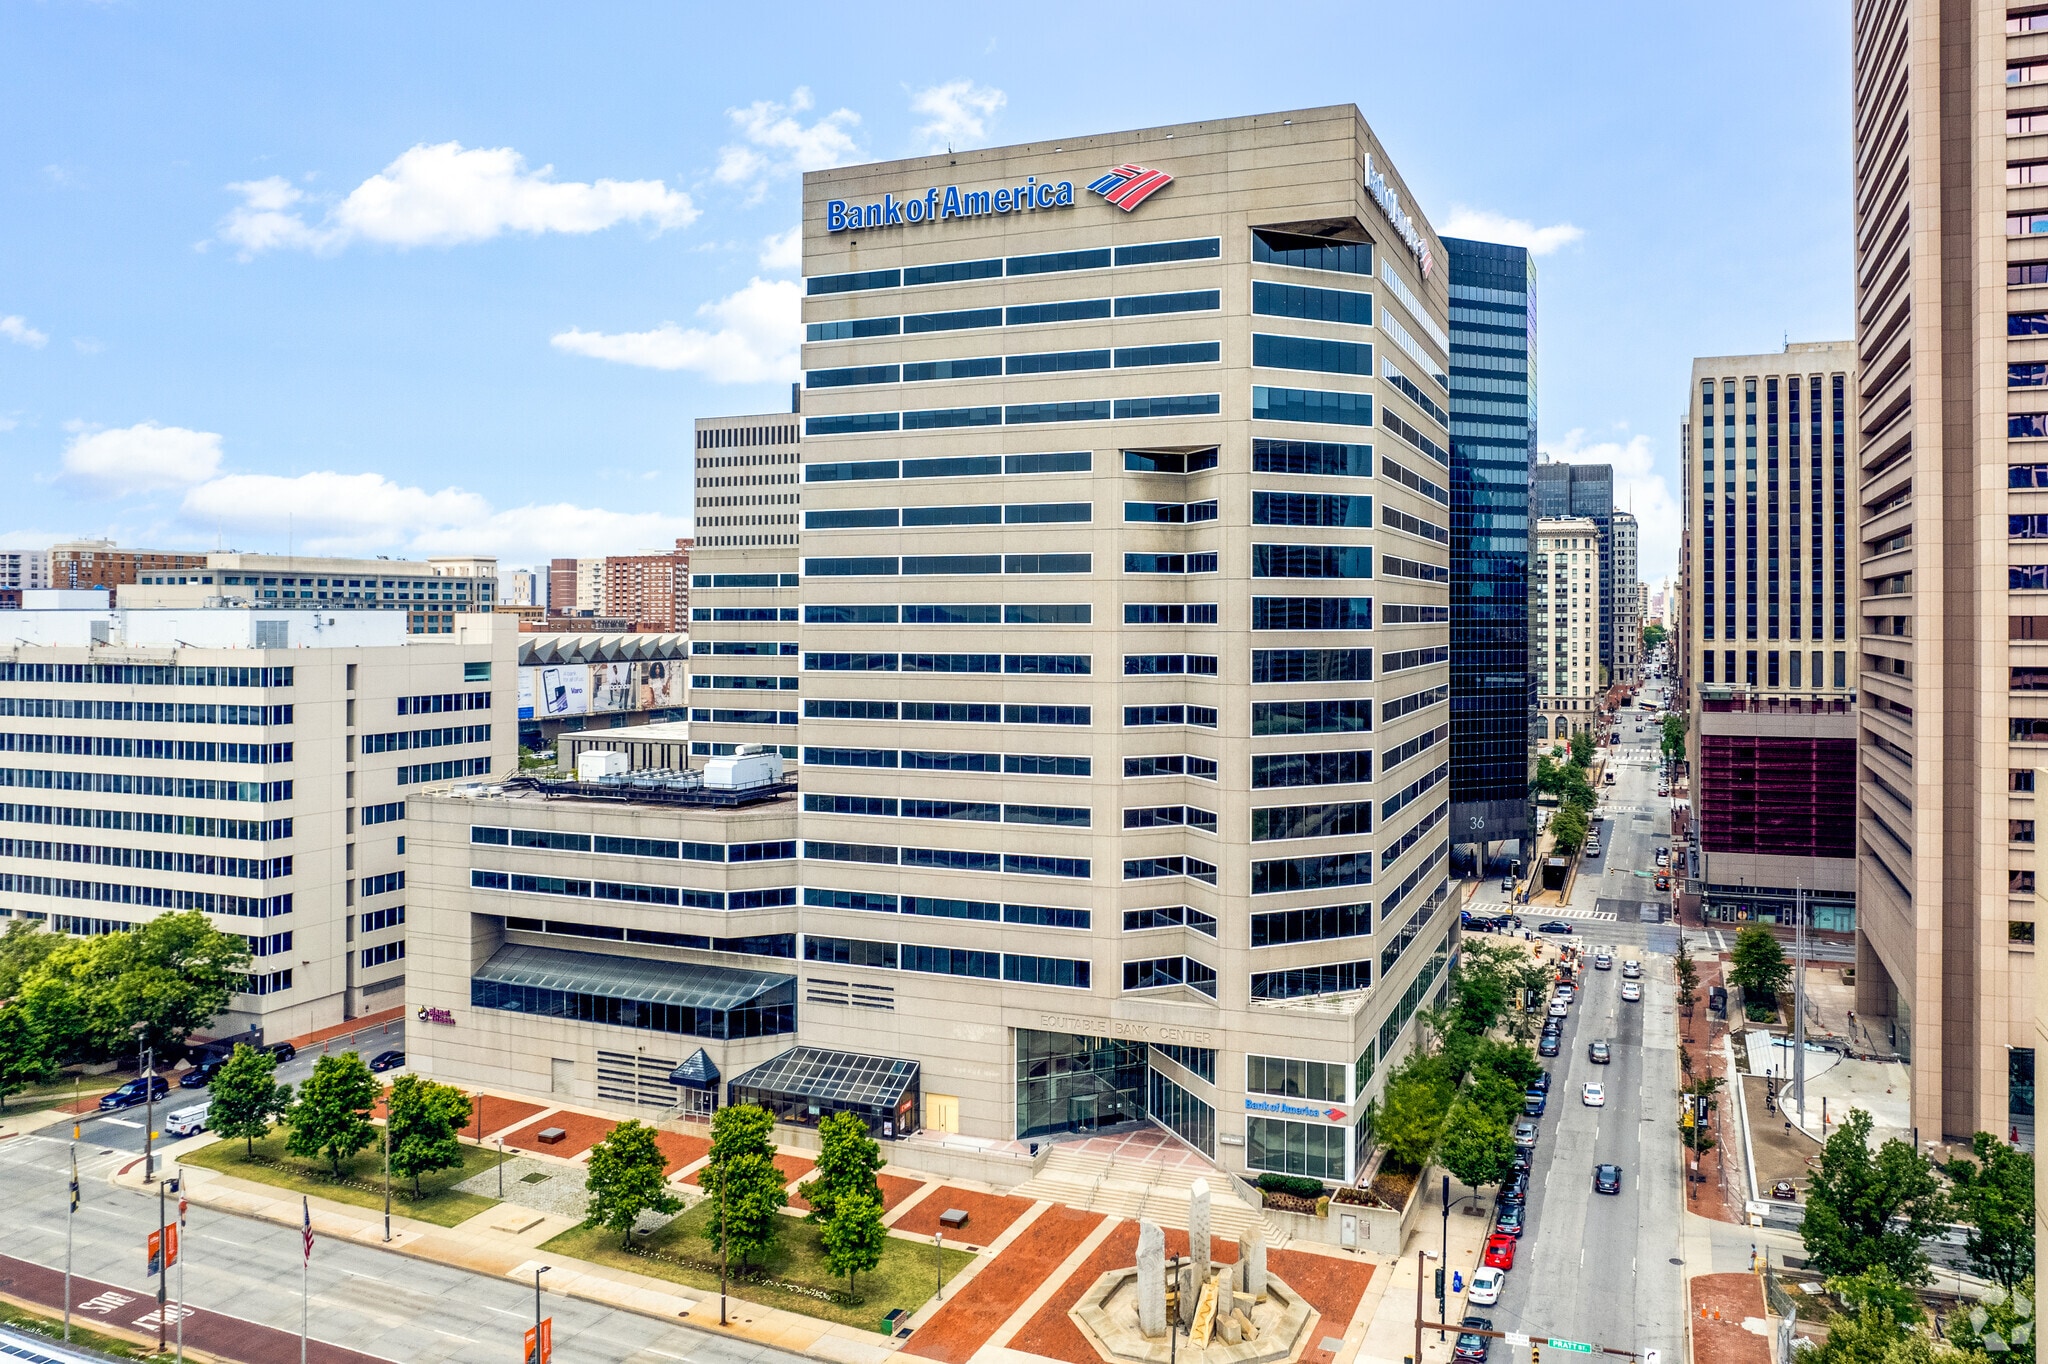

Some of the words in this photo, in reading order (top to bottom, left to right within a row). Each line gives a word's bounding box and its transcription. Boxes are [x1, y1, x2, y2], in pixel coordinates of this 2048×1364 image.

[827, 193, 903, 232] Bank
[905, 186, 938, 223] of
[940, 176, 1075, 219] America
[1470, 816, 1485, 830] 36
[1040, 1015, 1106, 1033] EQUITABLE
[1115, 1022, 1150, 1037] BANK
[1159, 1027, 1212, 1044] CENTER
[1245, 1098, 1269, 1111] Bank
[1269, 1103, 1280, 1112] of
[1280, 1103, 1320, 1117] America
[1552, 1340, 1577, 1350] PRATT
